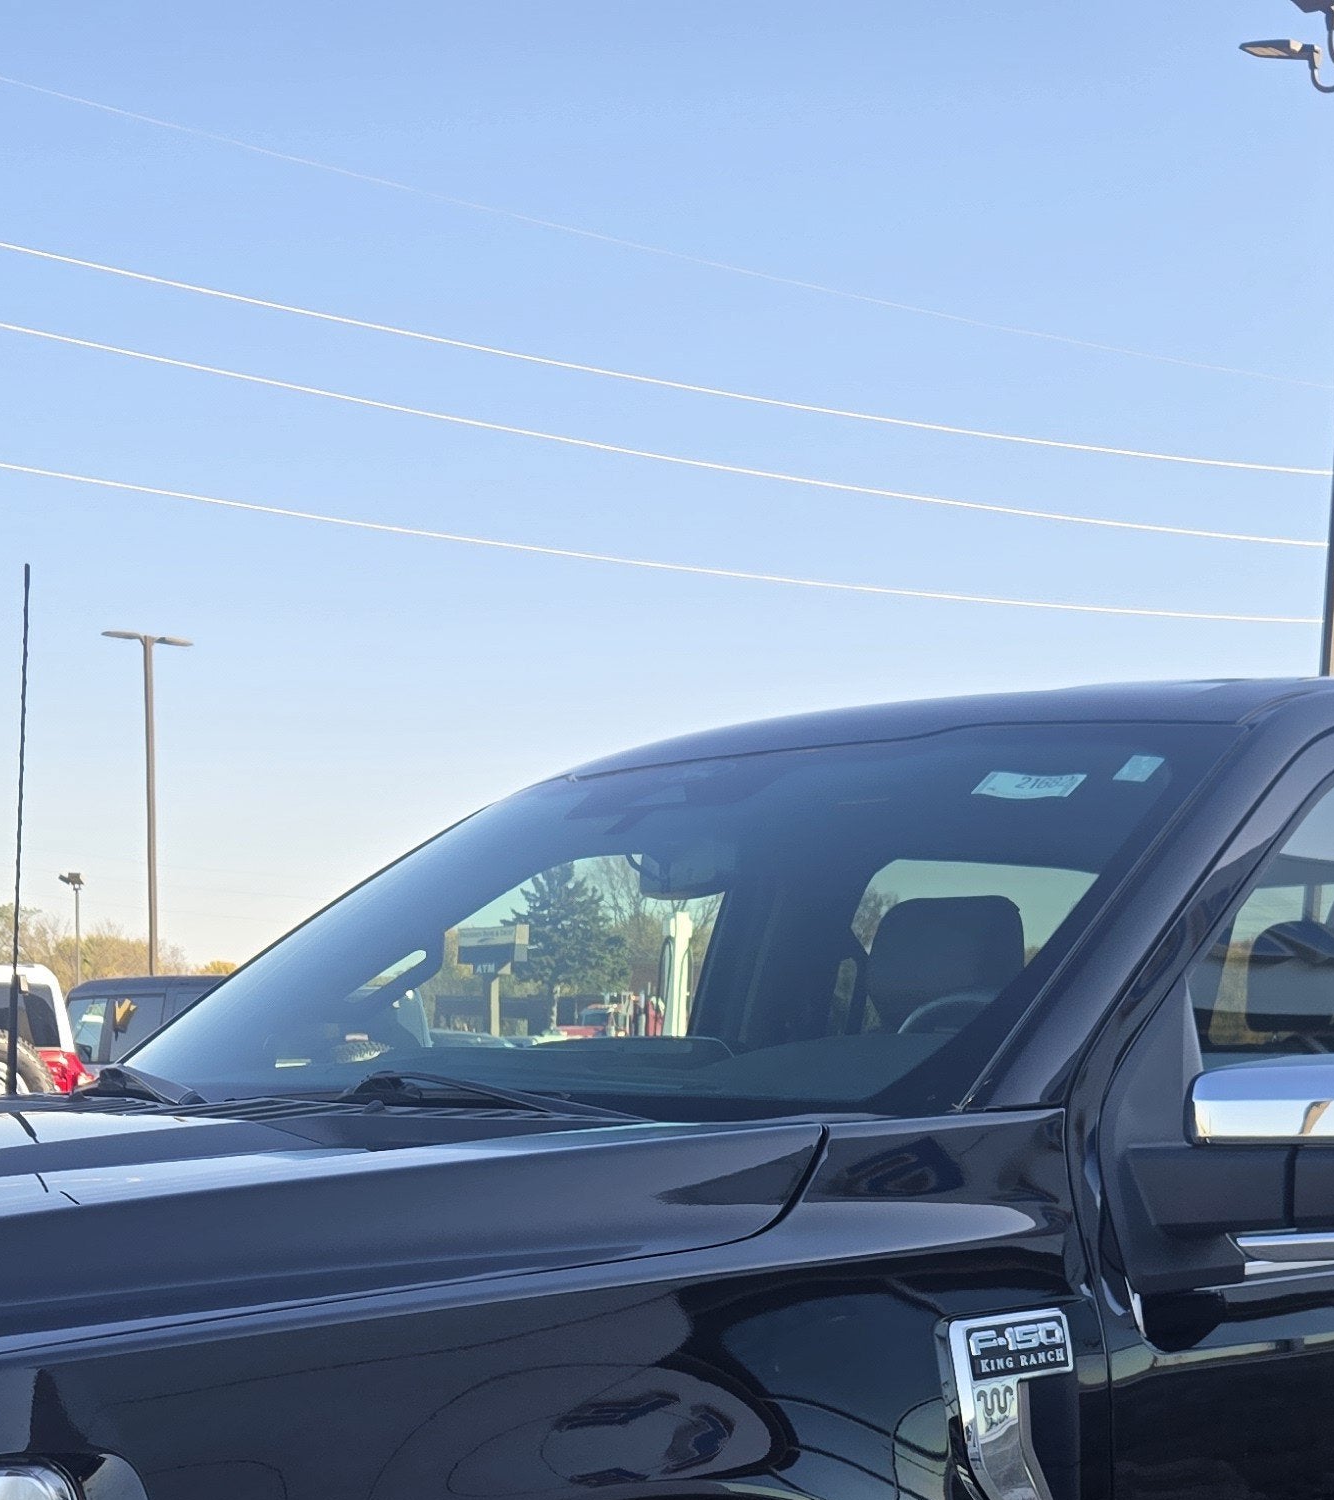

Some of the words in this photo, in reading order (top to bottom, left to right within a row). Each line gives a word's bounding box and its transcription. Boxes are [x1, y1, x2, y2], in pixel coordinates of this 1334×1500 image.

[476, 963, 495, 973] ATM
[969, 1321, 1064, 1356] F-150
[980, 1357, 1014, 1373] KING
[1019, 1348, 1065, 1367] RANCH
